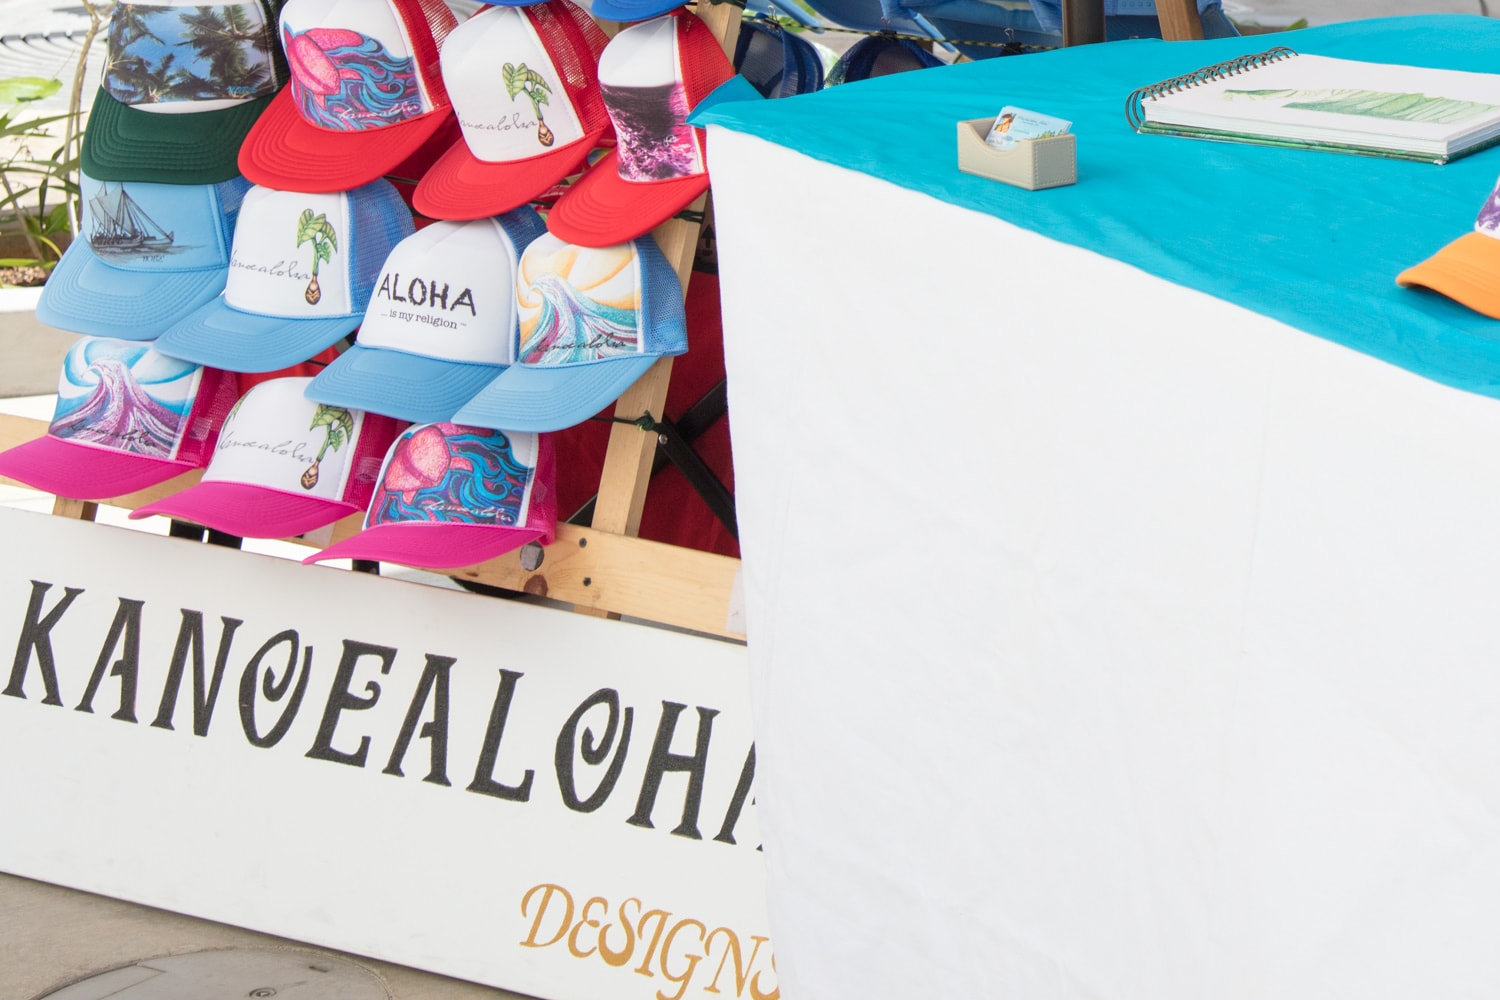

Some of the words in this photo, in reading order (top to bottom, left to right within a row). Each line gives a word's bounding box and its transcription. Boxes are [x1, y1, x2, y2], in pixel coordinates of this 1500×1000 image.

[377, 272, 476, 317] ALOHA
[389, 309, 397, 318] is
[399, 311, 414, 323] my
[415, 314, 458, 330] religion
